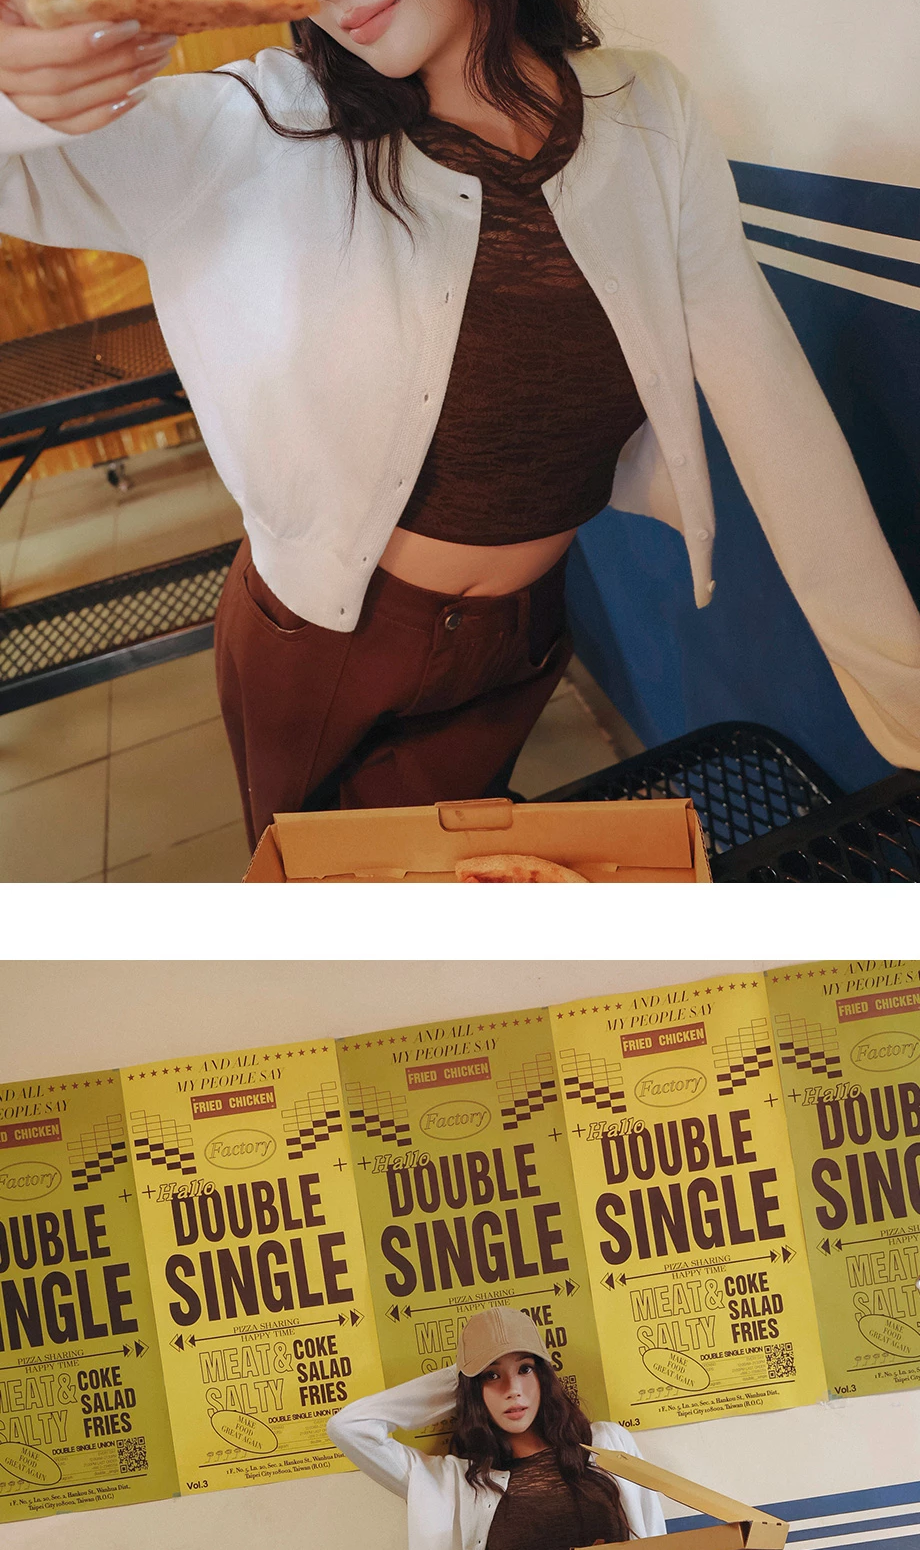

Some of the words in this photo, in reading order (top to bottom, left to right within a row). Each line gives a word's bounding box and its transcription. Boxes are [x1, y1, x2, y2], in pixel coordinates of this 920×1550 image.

[838, 1002, 868, 1017] FRIED
[415, 1028, 444, 1043] AND
[447, 1024, 474, 1038] ALL
[623, 1037, 652, 1051] FRIED
[659, 1028, 704, 1046] CHICKEN
[200, 1058, 230, 1072] AND
[232, 1054, 259, 1067] ALL
[391, 1052, 411, 1065] MY
[415, 1043, 472, 1061] PEOPLE
[474, 1038, 499, 1052] SAY
[176, 1080, 196, 1093] MY
[200, 1073, 258, 1090] PEOPLE
[259, 1068, 285, 1081] SAY
[408, 1071, 437, 1085] FRIED
[444, 1063, 489, 1079] CHICKEN
[638, 1077, 703, 1098] Factory
[802, 1082, 862, 1106] Hallo
[193, 1099, 223, 1114] FRIED
[229, 1092, 274, 1108] CHICKEN
[14, 1124, 60, 1140] CHICKEN
[424, 1110, 487, 1130] Factory
[586, 1117, 646, 1141] Hallo
[209, 1139, 272, 1159] Factory
[601, 1109, 757, 1185] DOUBLE
[372, 1150, 431, 1174] Hallo
[157, 1179, 216, 1202] Hallo
[386, 1143, 541, 1217] DOUBLE
[171, 1173, 326, 1246] DOUBLE
[595, 1168, 786, 1265] SINGLE
[381, 1202, 569, 1297] SINGLE
[165, 1231, 354, 1327] SINGLE
[724, 1272, 769, 1297] COKE
[630, 1279, 725, 1322] MEAT&
[728, 1294, 784, 1320] SALAD
[233, 1325, 258, 1333] PIZZA
[260, 1318, 300, 1330] SHARING
[241, 1332, 272, 1342] HAPPY
[273, 1329, 295, 1337] TIME
[731, 1318, 780, 1344] FRIES
[293, 1335, 338, 1360] COKE
[199, 1342, 293, 1384] MEAT&
[296, 1357, 351, 1383] SALAD
[77, 1366, 122, 1391] COKE
[834, 1385, 857, 1394] Vol.3
[81, 1388, 136, 1414] SALAD
[205, 1378, 284, 1418] SALTY
[299, 1382, 348, 1406] FRIES
[83, 1412, 132, 1438] FRIES
[187, 1480, 208, 1490] Vol.3
